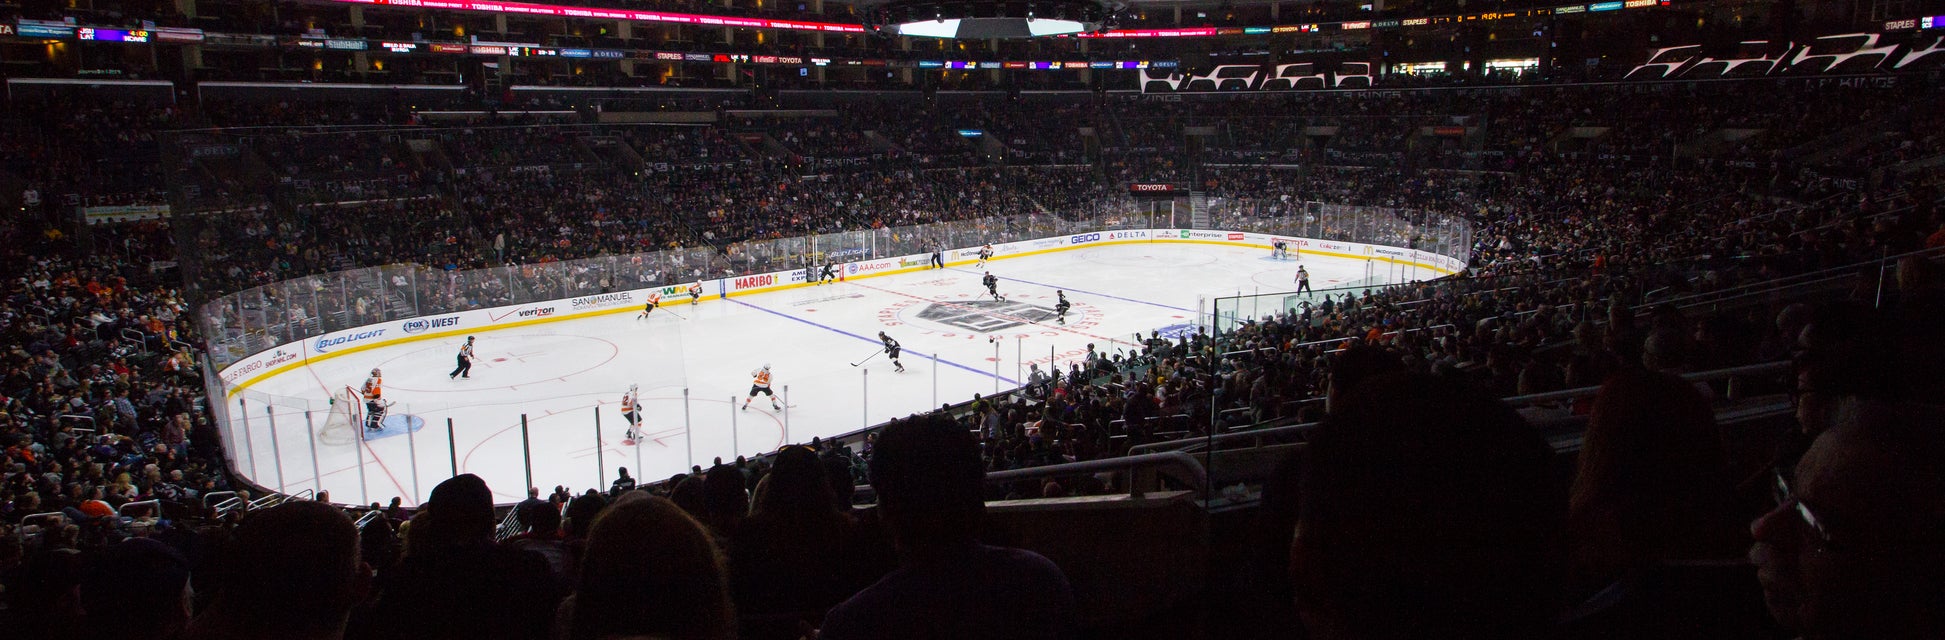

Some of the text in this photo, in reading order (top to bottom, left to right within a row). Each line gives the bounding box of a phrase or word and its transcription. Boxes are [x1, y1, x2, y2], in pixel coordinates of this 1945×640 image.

[1625, 0, 1657, 8] TOSHIBA
[1886, 20, 1916, 30] STAPLES
[1071, 233, 1100, 244] GEICO
[859, 262, 892, 272] AAA.com
[735, 276, 772, 290] HARIBO
[572, 298, 590, 307] SAN
[597, 292, 632, 303] MANUEL
[518, 306, 554, 316] verizon
[408, 316, 460, 329] FOX WEST
[318, 328, 387, 349] BUD LIGHT
[239, 360, 263, 377] FARGO
